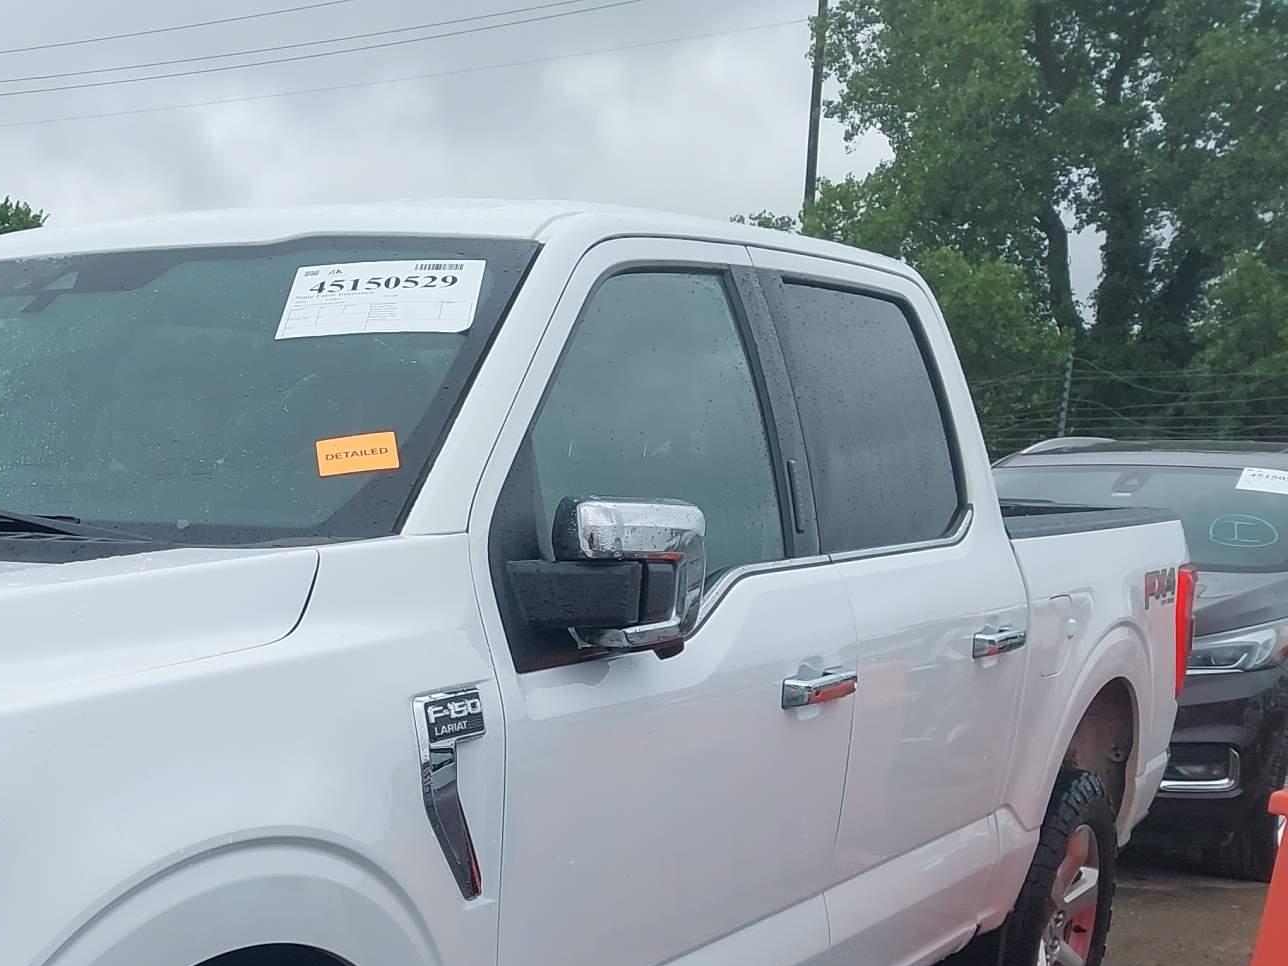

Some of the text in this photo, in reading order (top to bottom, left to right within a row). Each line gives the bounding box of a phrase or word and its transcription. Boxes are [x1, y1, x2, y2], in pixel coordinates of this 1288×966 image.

[309, 275, 458, 294] 45150529
[325, 447, 389, 461] DETAILED
[1144, 567, 1176, 609] FX4
[427, 698, 482, 723] F-150
[434, 720, 468, 736] LARIAT
